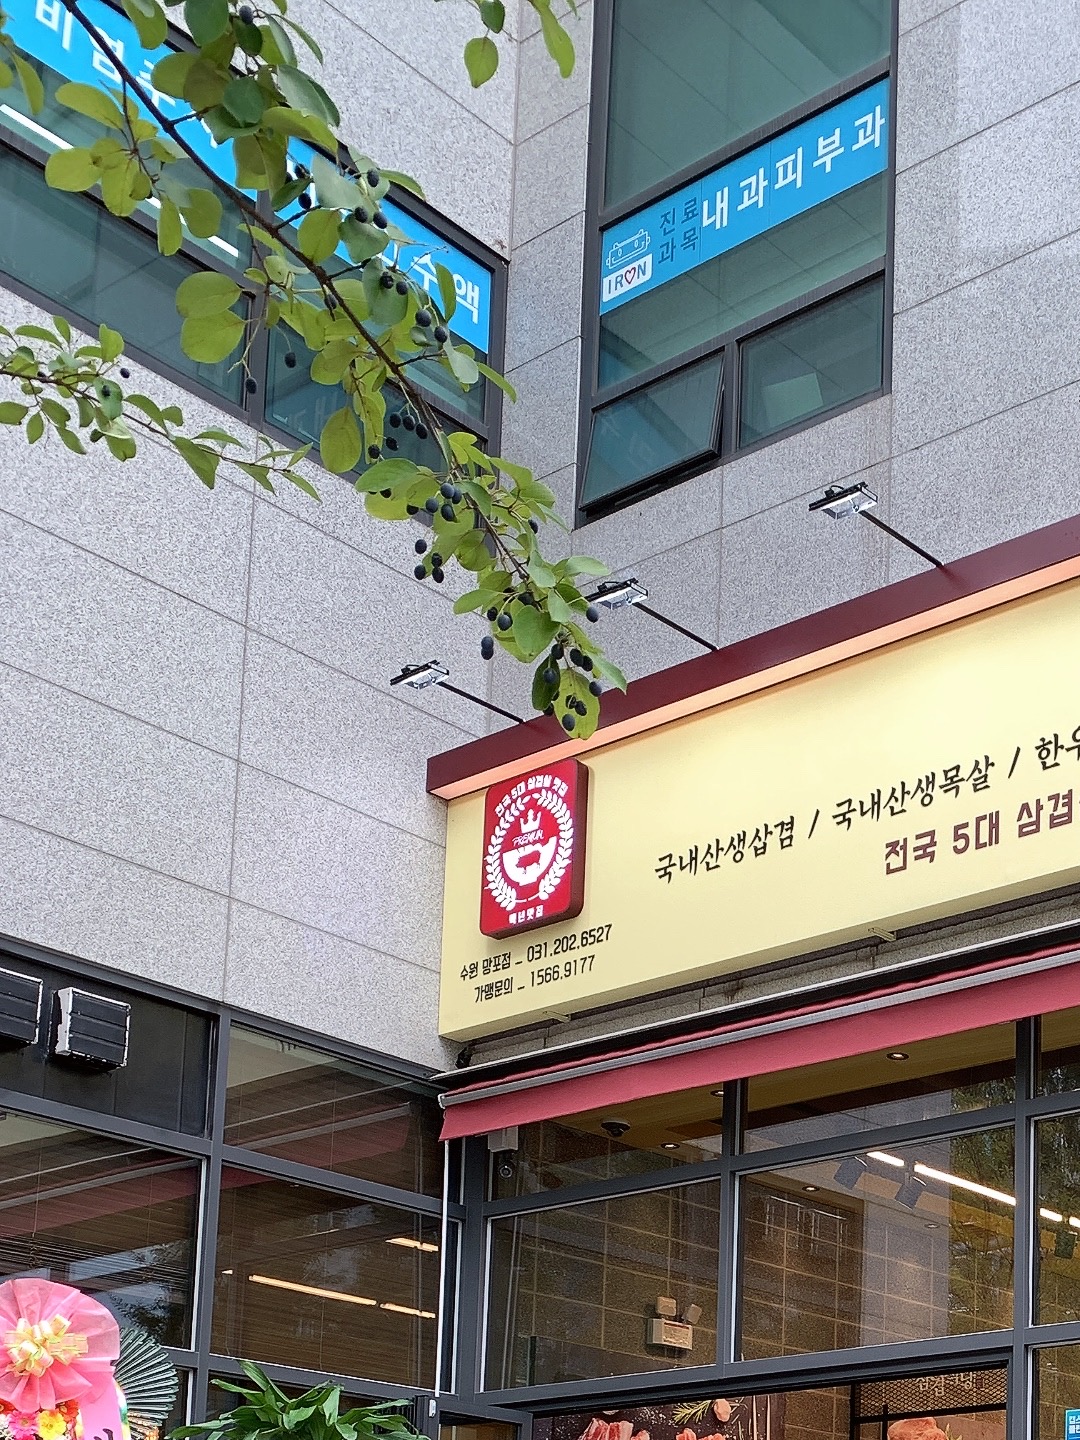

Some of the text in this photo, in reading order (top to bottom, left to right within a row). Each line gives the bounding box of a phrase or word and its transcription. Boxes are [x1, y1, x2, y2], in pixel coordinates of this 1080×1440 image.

[702, 104, 886, 230] 내과피부과
[657, 225, 699, 265] 과목
[659, 197, 699, 236] 진료
[832, 754, 995, 831] 국내산생목살
[885, 829, 938, 875] 전국
[953, 810, 1000, 855] 5대
[460, 961, 478, 982] 수원
[482, 951, 511, 974] 망포점
[527, 924, 612, 962] 031.202.6527
[474, 976, 513, 1003] 가맹문의
[530, 954, 595, 988] 1566.9177
